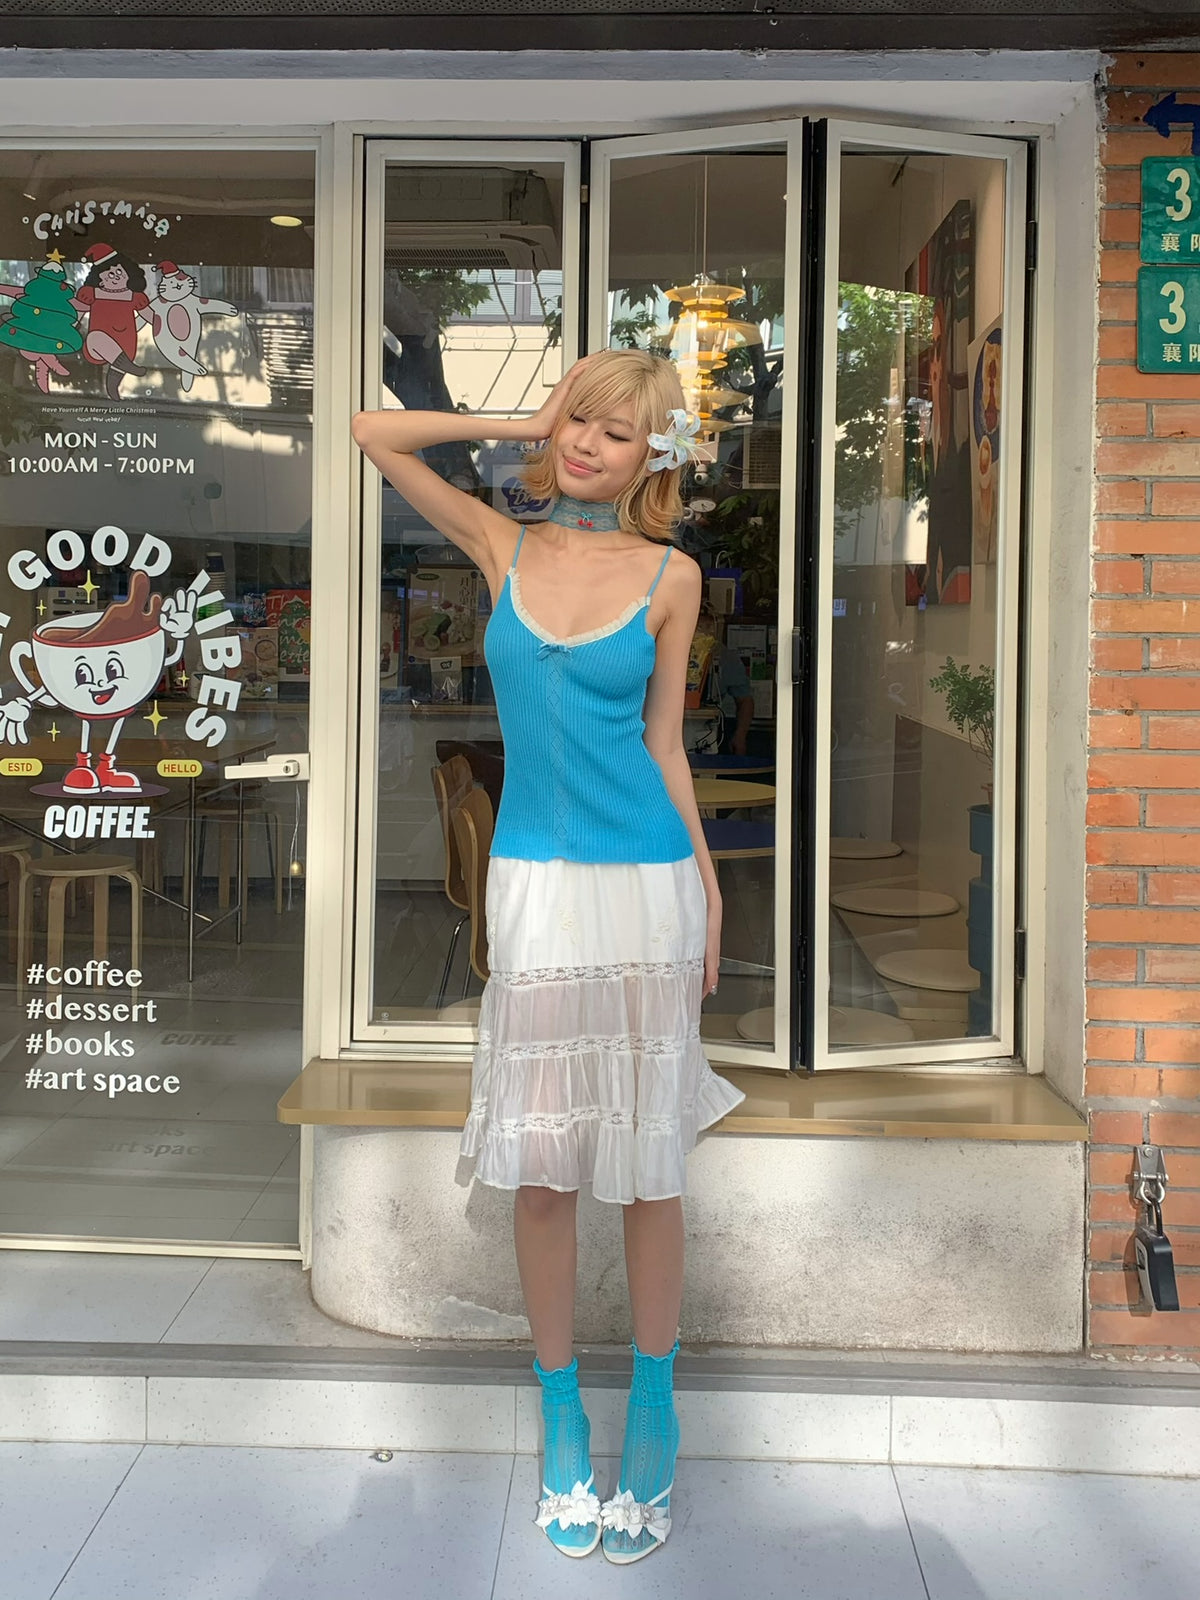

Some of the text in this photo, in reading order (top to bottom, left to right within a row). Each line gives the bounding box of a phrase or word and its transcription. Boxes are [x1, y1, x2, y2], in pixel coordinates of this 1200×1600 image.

[1166, 168, 1192, 221] 3
[1159, 281, 1186, 334] 3
[44, 432, 97, 448] MON
[113, 432, 157, 449] SUN
[7, 457, 98, 473] 10:00AM
[118, 457, 195, 474] 7:00PM
[7, 525, 172, 591] GOOD
[8, 762, 33, 772] ESTD
[163, 763, 198, 774] HELLO
[26, 959, 143, 987] #coffee
[26, 994, 157, 1023] #dessert
[25, 1029, 135, 1057] #books
[25, 1068, 181, 1099] #art space
